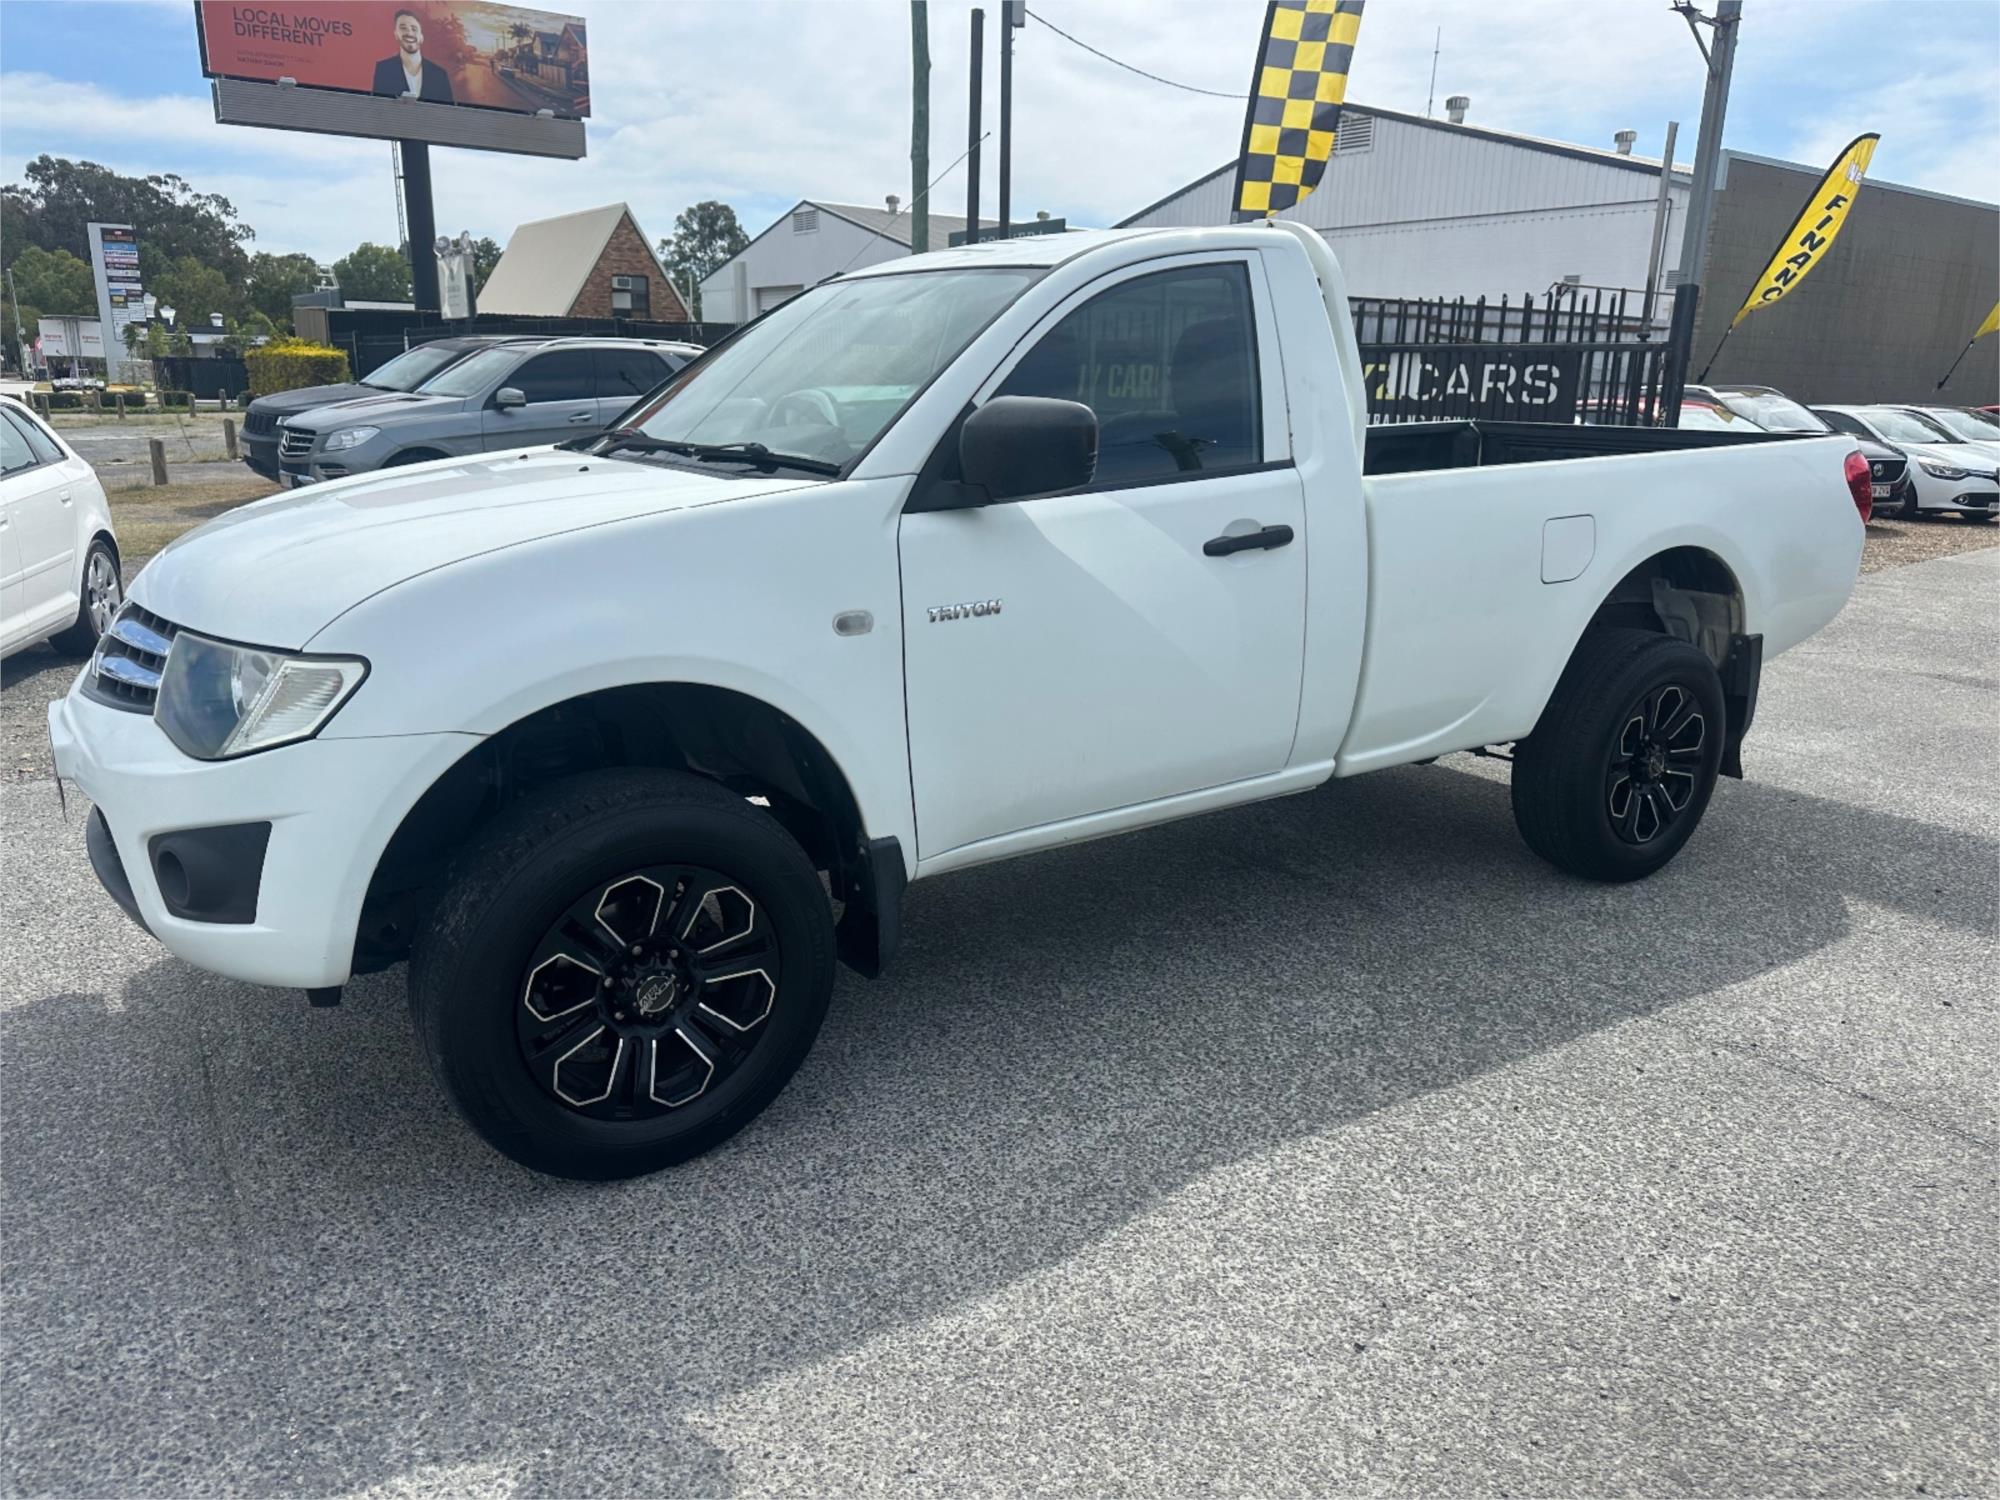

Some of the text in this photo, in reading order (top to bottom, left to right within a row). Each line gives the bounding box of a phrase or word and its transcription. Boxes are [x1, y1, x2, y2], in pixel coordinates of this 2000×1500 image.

[233, 6, 353, 37] LOCAL MOVES
[234, 22, 325, 47] DIFFERENT
[1757, 194, 1848, 304] FINANC
[1408, 362, 1561, 404] CARS
[927, 599, 1002, 623] TRITON
